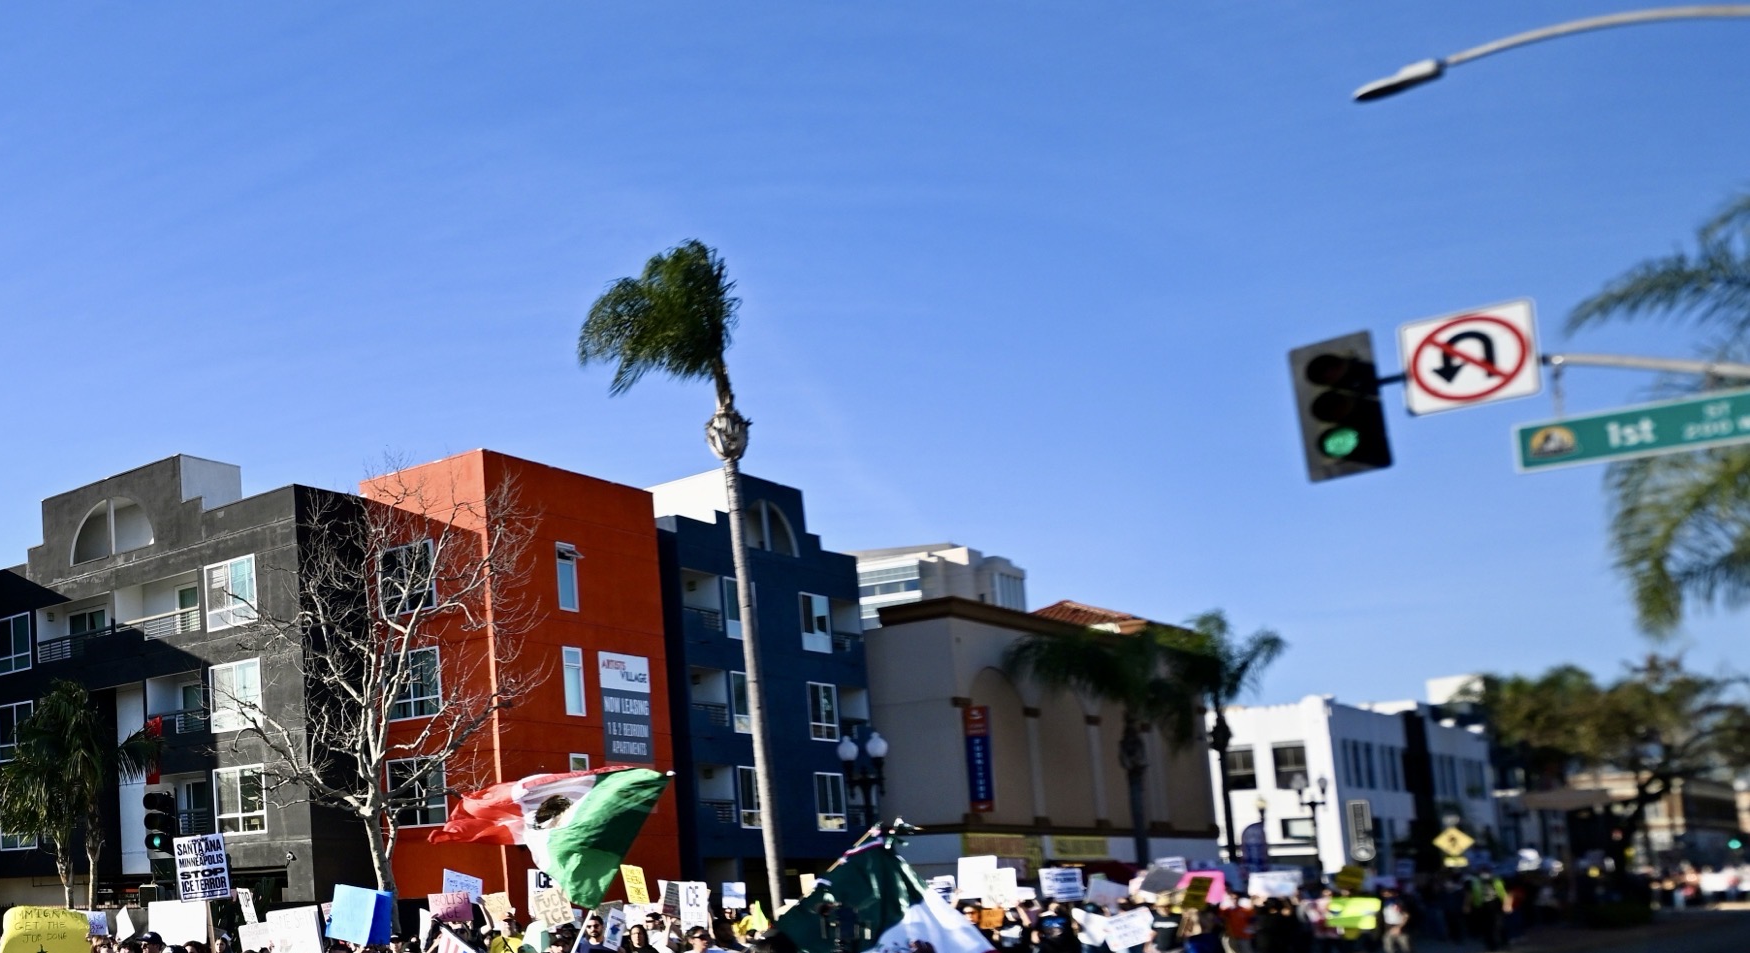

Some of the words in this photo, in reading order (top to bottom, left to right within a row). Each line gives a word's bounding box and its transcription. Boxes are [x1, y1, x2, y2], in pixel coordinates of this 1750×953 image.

[1605, 417, 1657, 449] 1st
[620, 670, 647, 683] VILLAGE
[603, 696, 620, 713] NOW
[622, 698, 649, 716] LEASING
[623, 723, 649, 738] BEDROOM
[612, 740, 647, 755] APARTMENTS
[176, 841, 204, 856] SANTA
[204, 838, 222, 852] ANA
[178, 853, 224, 868] MINNEAPOLIS
[180, 867, 225, 880] STOP
[181, 878, 194, 892] ICE
[195, 876, 227, 891] TERROR
[431, 892, 471, 906] ABOLISH
[534, 888, 568, 912] FUCK
[441, 907, 462, 920] ICE
[539, 907, 571, 926] ICE
[14, 921, 39, 931] GET
[47, 921, 66, 930] THE
